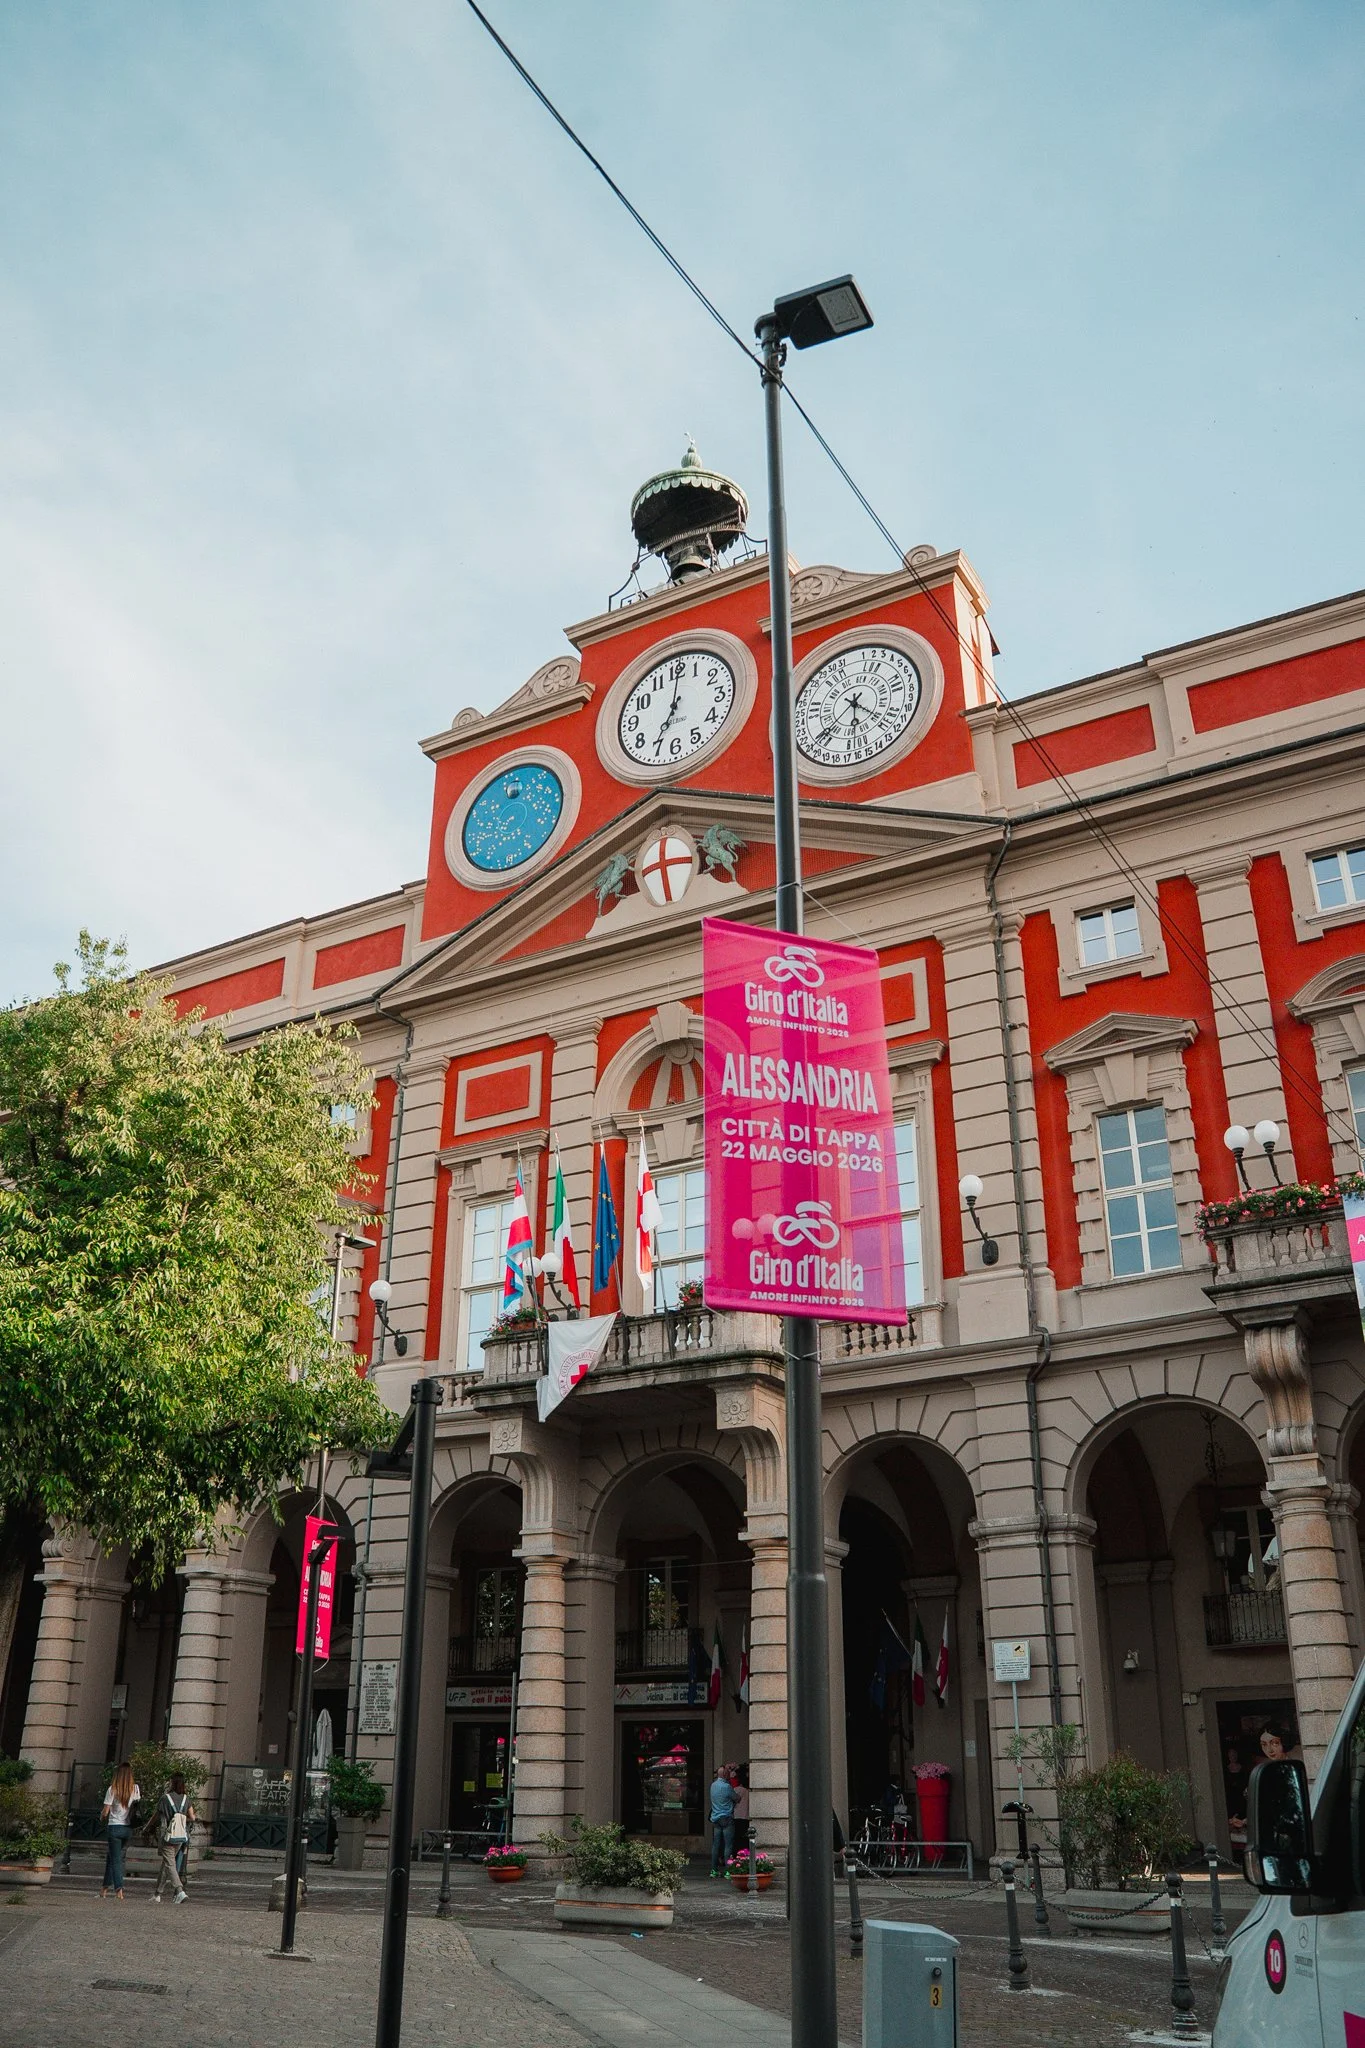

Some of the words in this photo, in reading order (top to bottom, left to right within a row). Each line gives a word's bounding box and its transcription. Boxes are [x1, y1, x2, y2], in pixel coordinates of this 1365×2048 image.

[872, 650, 876, 658] 2
[881, 650, 886, 658] 3
[890, 654, 894, 662] 4
[838, 659, 846, 667] 31
[897, 659, 903, 667] 5
[669, 662, 686, 681] 12
[692, 662, 699, 678] 1
[828, 664, 837, 673] 30
[904, 666, 909, 674] 6
[706, 668, 718, 686] 2
[818, 671, 827, 679] 29
[907, 674, 912, 683] 7
[652, 674, 664, 692] 11
[811, 680, 819, 688] 28
[909, 684, 914, 692] 8
[714, 686, 726, 703] 3
[804, 690, 812, 698] 27
[908, 693, 913, 701] 9
[636, 693, 651, 712] 10
[798, 699, 807, 708] 26
[905, 703, 912, 712] 10
[704, 707, 719, 724] 4
[796, 709, 805, 718] 25
[795, 718, 805, 727] 24
[901, 714, 907, 723] 11
[628, 715, 639, 732] 9
[797, 728, 806, 737] 23
[893, 724, 901, 733] 12
[635, 732, 645, 749] 8
[690, 727, 701, 745] 5
[800, 736, 808, 745] 22
[885, 733, 892, 742] 13
[669, 738, 682, 755] 6
[847, 735, 868, 750] GOV
[875, 740, 883, 750] 14
[653, 738, 664, 757] 7
[865, 747, 873, 756] 15
[813, 749, 821, 758] 20
[822, 752, 830, 762] 19
[844, 753, 851, 762] 17
[855, 751, 862, 760] 16
[832, 754, 840, 763] 18
[745, 982, 784, 1016] Giro
[787, 990, 848, 1025] d'Italia
[746, 1015, 782, 1028] AMORE
[782, 1020, 825, 1034] INFINITO
[721, 1052, 879, 1114] ALESSANDRIA
[721, 1116, 785, 1141] CITTÀ
[789, 1123, 810, 1144] DI
[814, 1127, 881, 1152] TAPPA
[721, 1140, 745, 1159] 22
[749, 1143, 834, 1168] MAGGIO
[837, 1152, 884, 1173] 2026
[749, 1250, 793, 1287] Giro
[796, 1254, 864, 1292] d'Italia
[750, 1291, 789, 1302] AMORE
[790, 1294, 838, 1305] INFINITO
[495, 1694, 512, 1704] pubb
[1269, 1948, 1281, 1973] 10
[932, 1987, 939, 2006] 3
